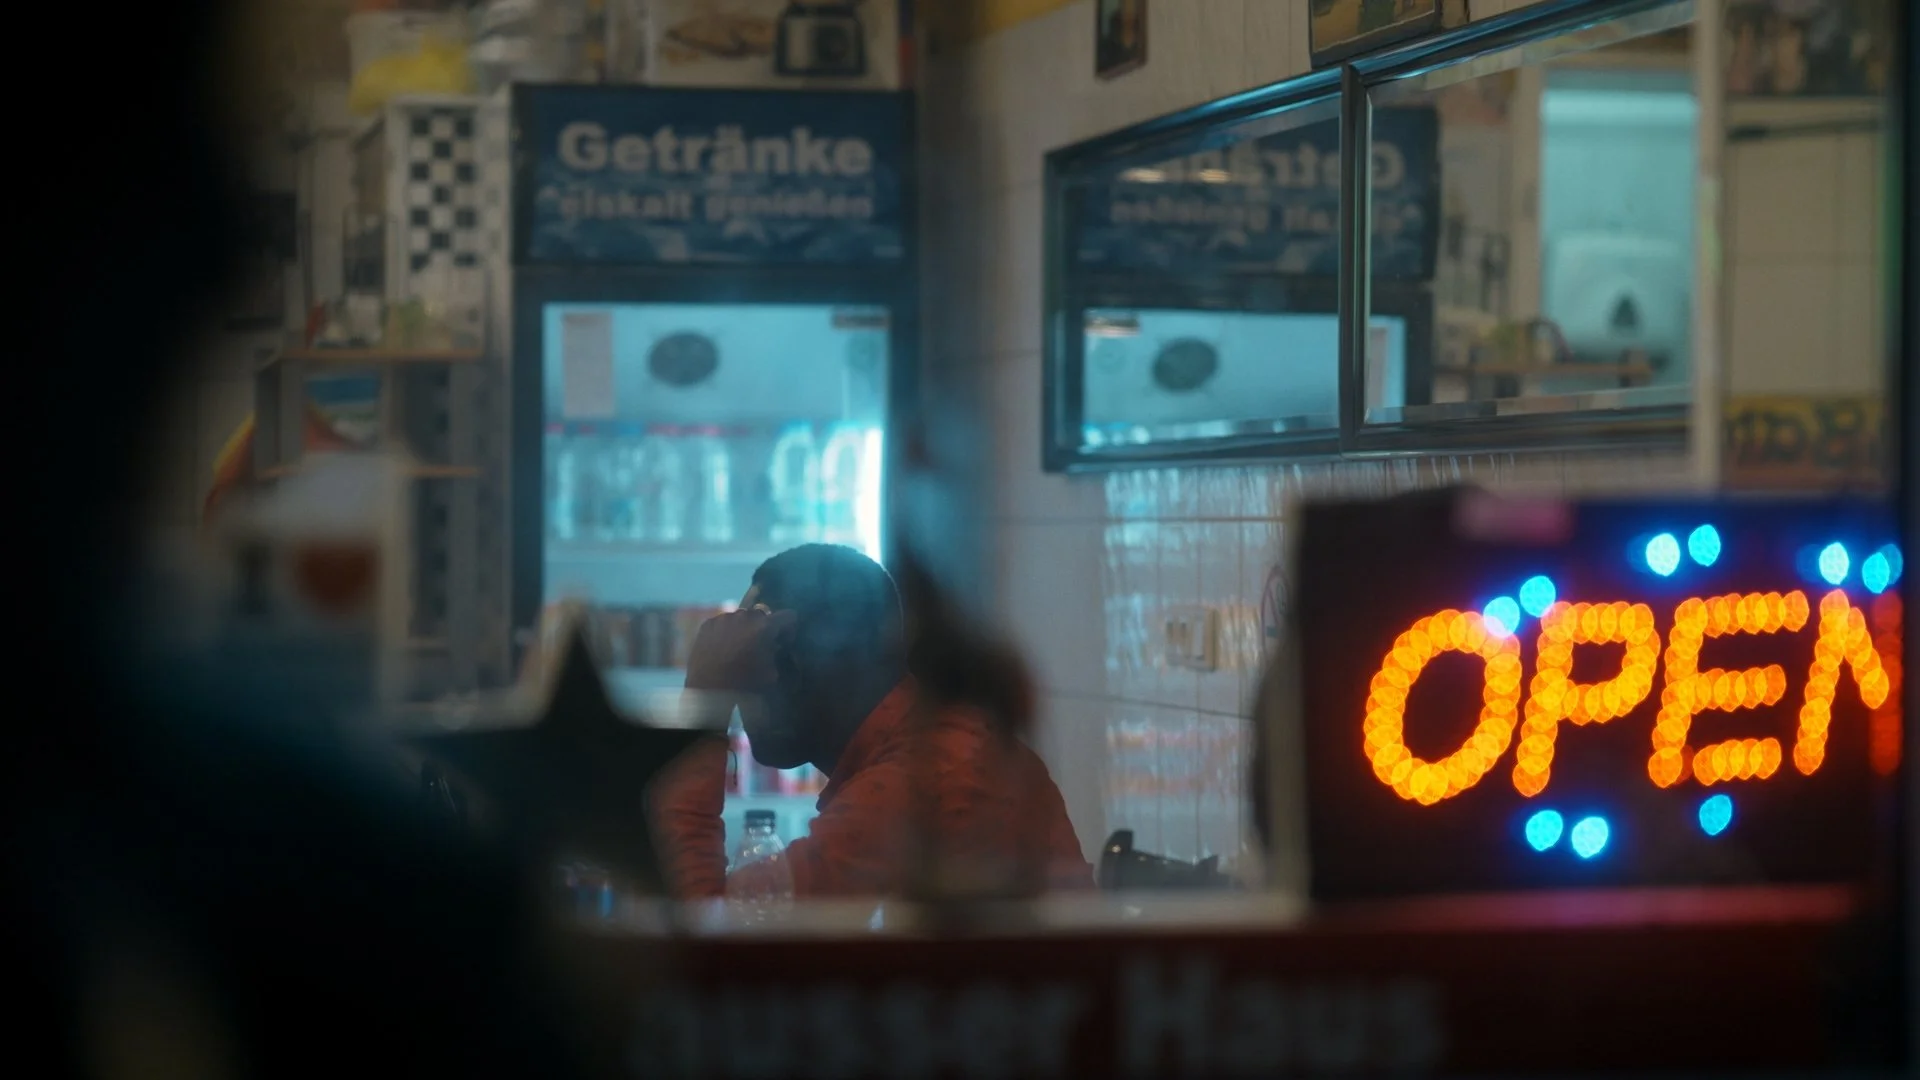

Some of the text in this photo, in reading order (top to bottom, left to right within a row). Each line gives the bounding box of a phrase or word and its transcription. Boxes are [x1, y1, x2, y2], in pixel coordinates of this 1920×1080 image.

[557, 120, 874, 177] Getränke
[1364, 589, 1902, 806] OPEN
[1116, 951, 1448, 1076] Haus
